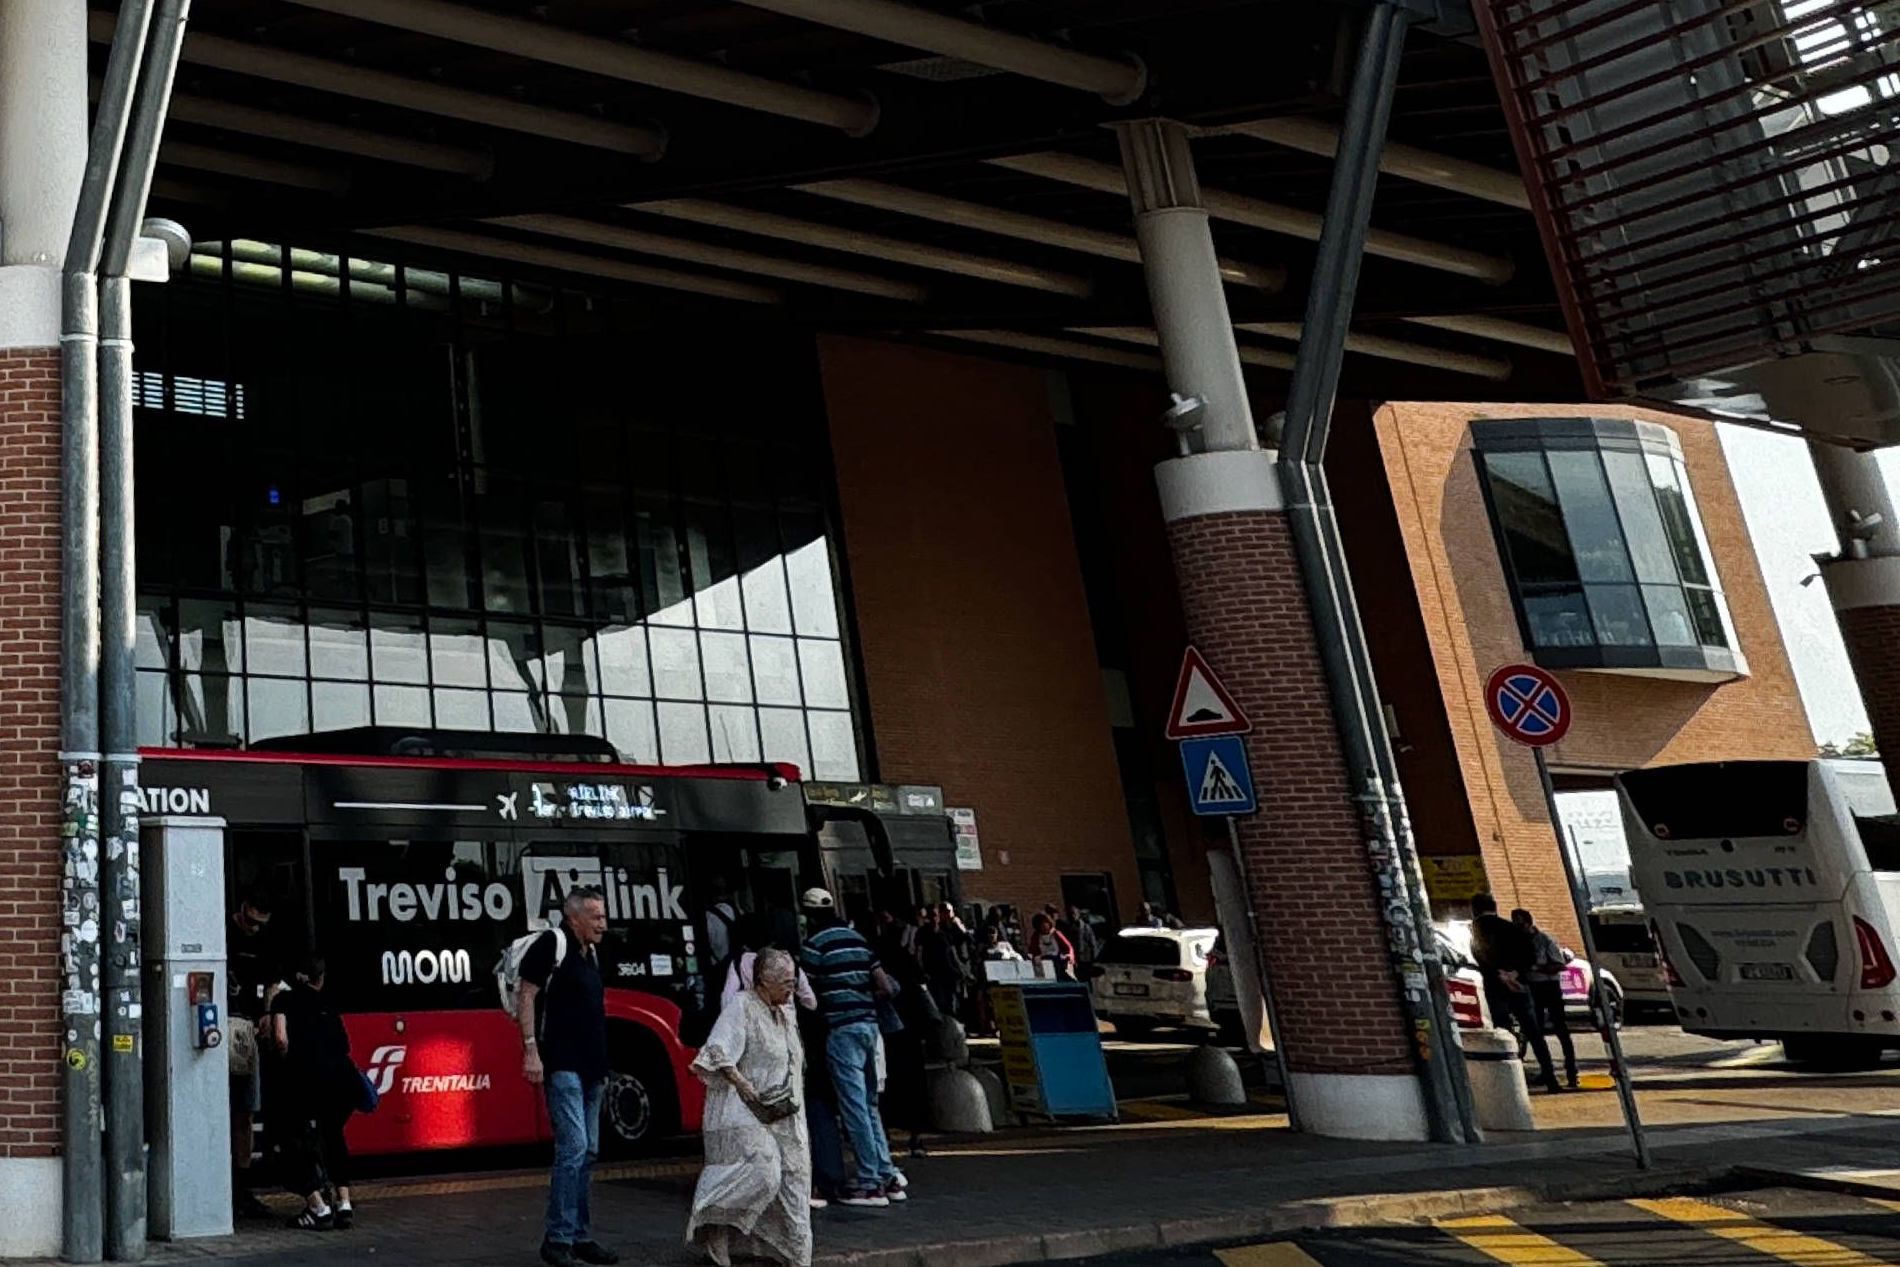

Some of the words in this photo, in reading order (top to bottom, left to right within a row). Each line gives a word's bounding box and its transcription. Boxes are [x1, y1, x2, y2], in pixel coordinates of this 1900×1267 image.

[136, 786, 210, 814] ATION
[1663, 865, 1817, 889] BRUSUTTI
[339, 866, 513, 921] Treviso
[538, 865, 689, 921] Alink
[382, 949, 471, 985] MOM
[402, 1074, 491, 1093] TRENITALIA
